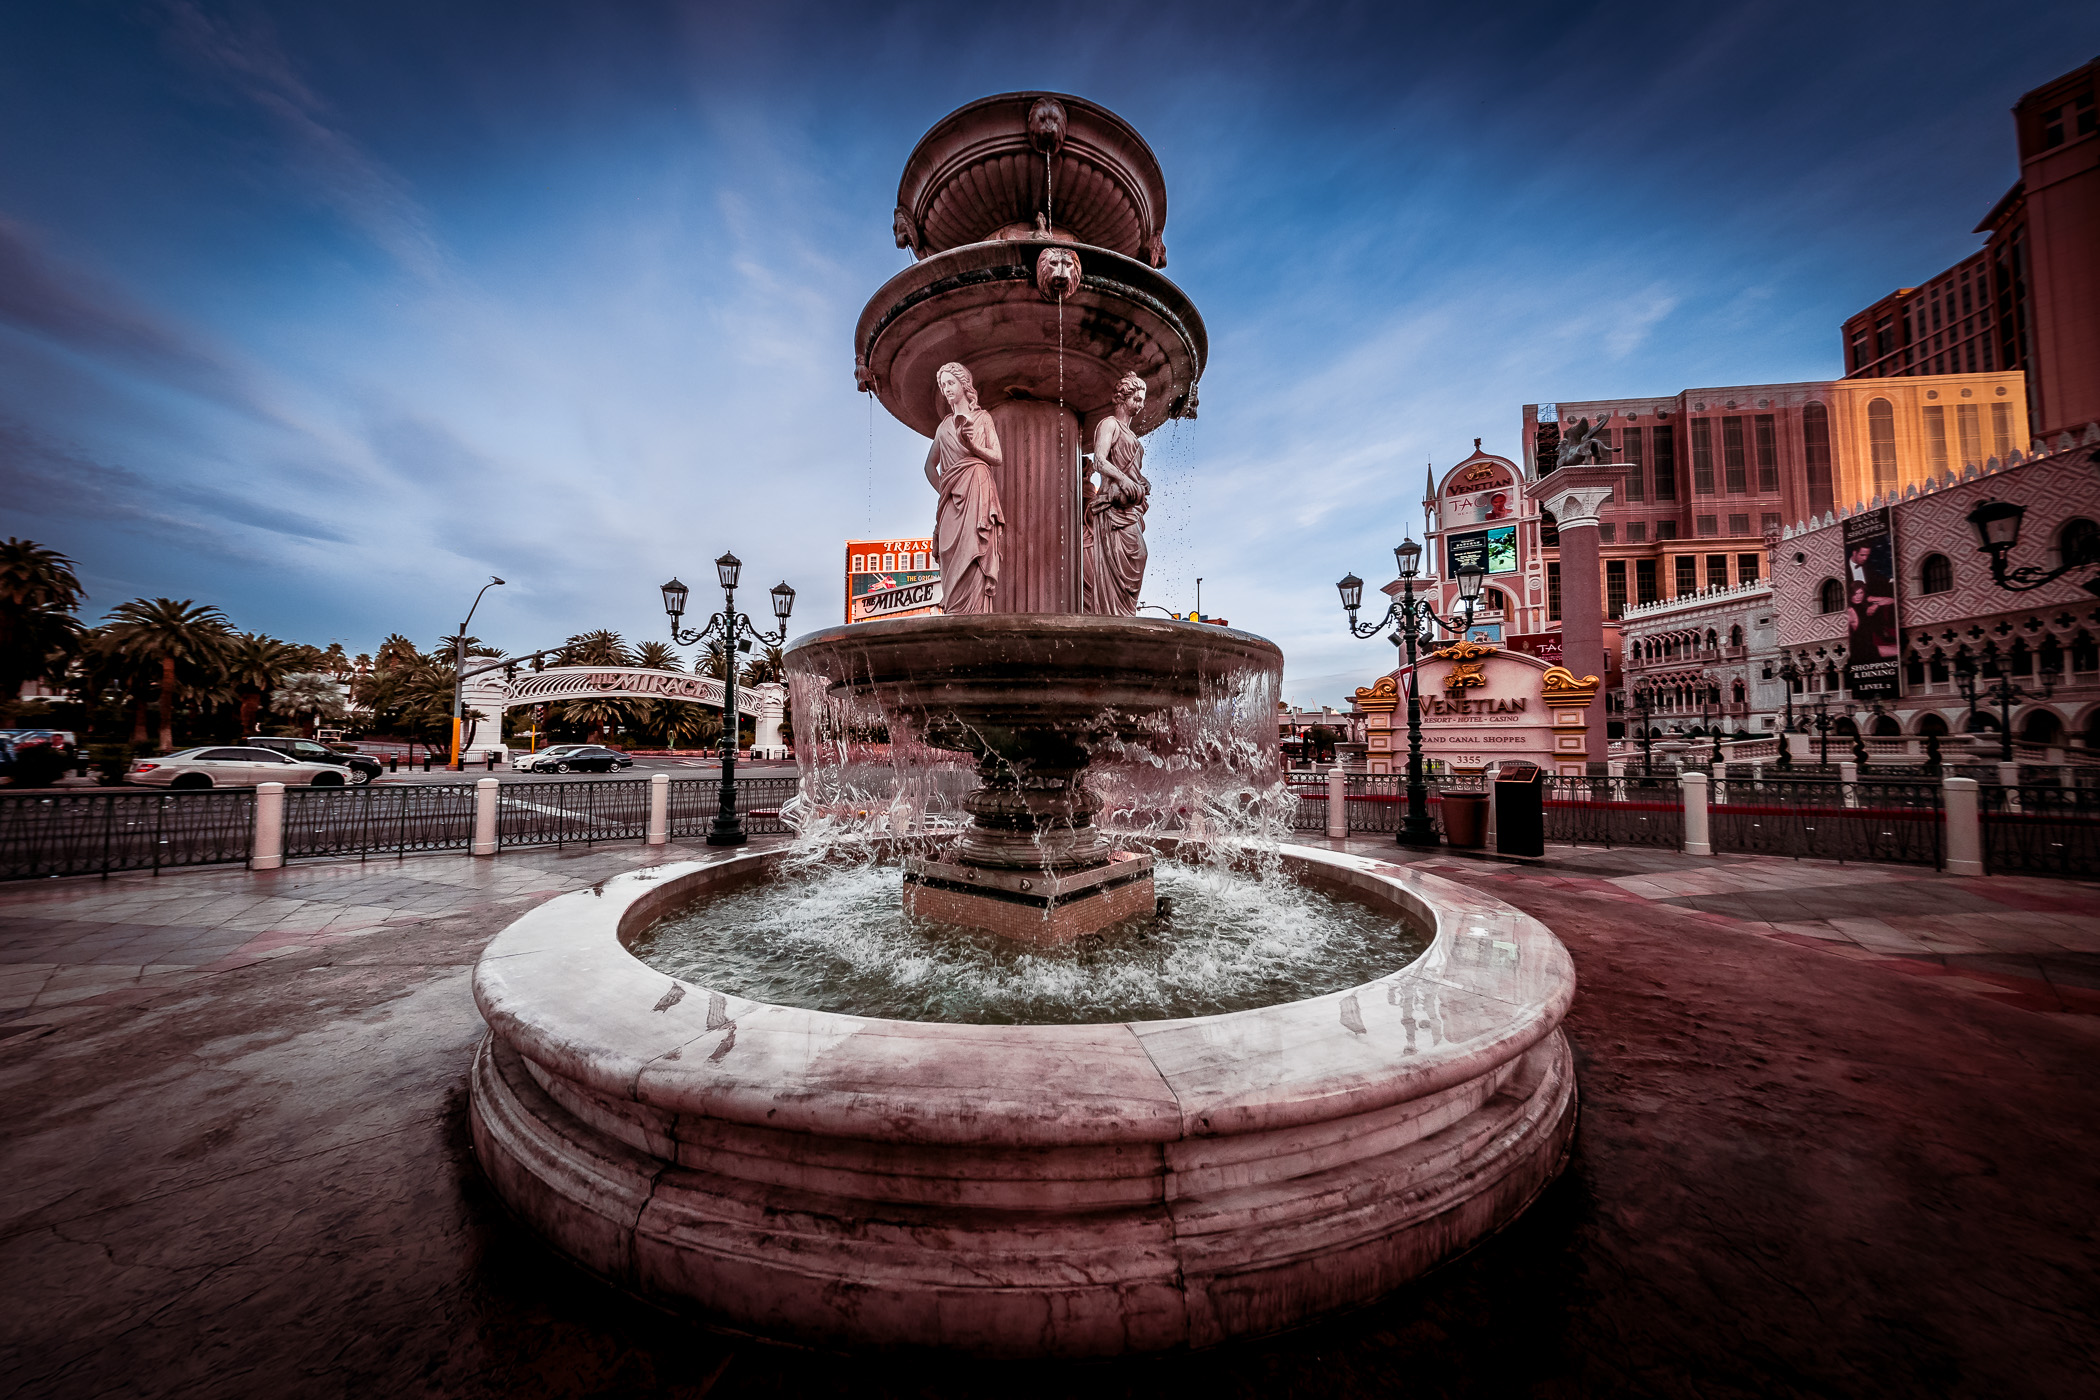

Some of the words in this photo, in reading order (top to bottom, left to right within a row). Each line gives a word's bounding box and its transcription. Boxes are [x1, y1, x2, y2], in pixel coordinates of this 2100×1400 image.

[1448, 478, 1511, 496] VENETIAN
[1449, 496, 1487, 512] TAO
[1849, 510, 1880, 524] GRAND
[1851, 518, 1880, 530] CANAL
[1848, 522, 1886, 538] SHOPPES
[862, 597, 876, 608] THE
[865, 585, 934, 613] MIRAGE
[1850, 661, 1898, 672] SHOPPING
[1861, 669, 1896, 678] DINING
[588, 672, 617, 686] THE
[597, 673, 709, 697] MIRAGE
[1443, 689, 1467, 699] THE
[1419, 695, 1526, 717] VENETIAN
[1456, 755, 1481, 764] 3355
